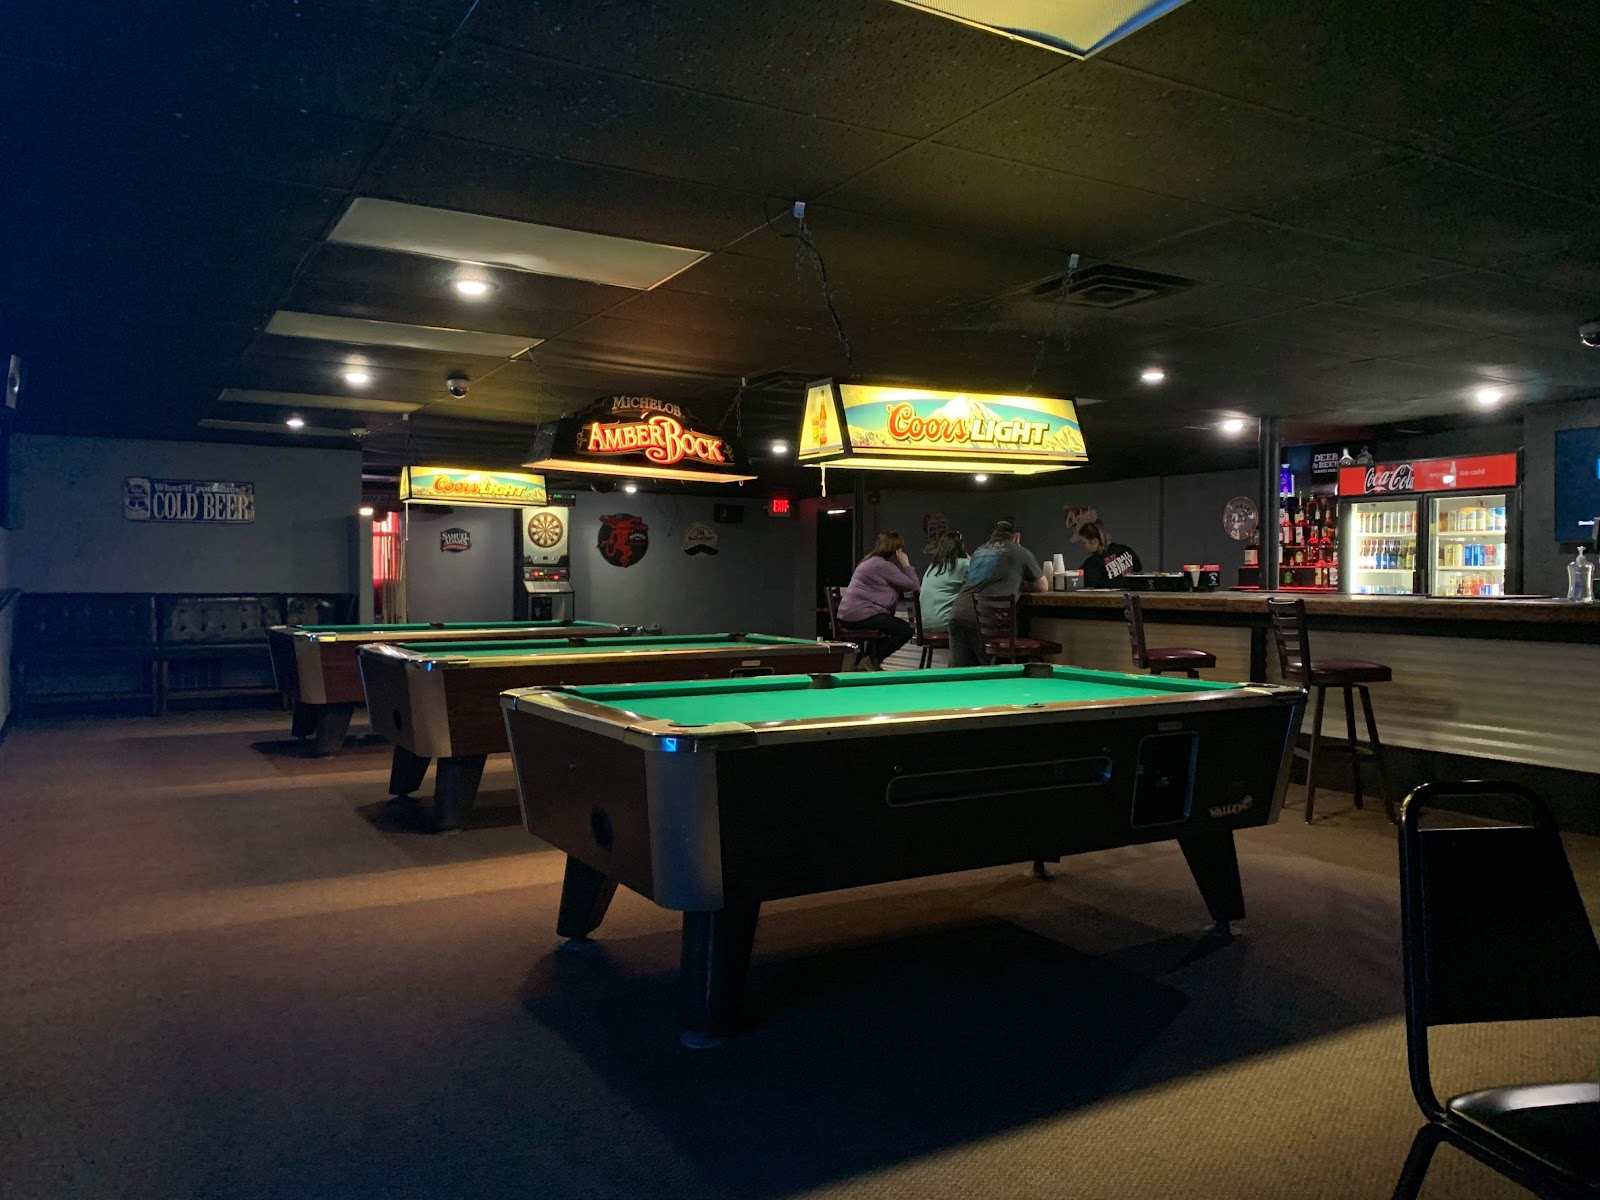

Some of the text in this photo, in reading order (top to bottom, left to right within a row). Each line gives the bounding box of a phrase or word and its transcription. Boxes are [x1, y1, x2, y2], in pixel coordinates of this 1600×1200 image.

[611, 395, 682, 417] MICHELOB
[885, 402, 1050, 445] Coors LIGHT
[1313, 452, 1338, 462] DEER
[433, 474, 527, 497] Coors LIGHT
[1364, 464, 1415, 494] Coca-Cola
[153, 492, 249, 520] COLD BEER
[773, 499, 788, 512] EXIT
[442, 532, 469, 540] SAMUEL
[444, 537, 468, 546] ADAMS
[1107, 557, 1134, 579] FRIDAY
